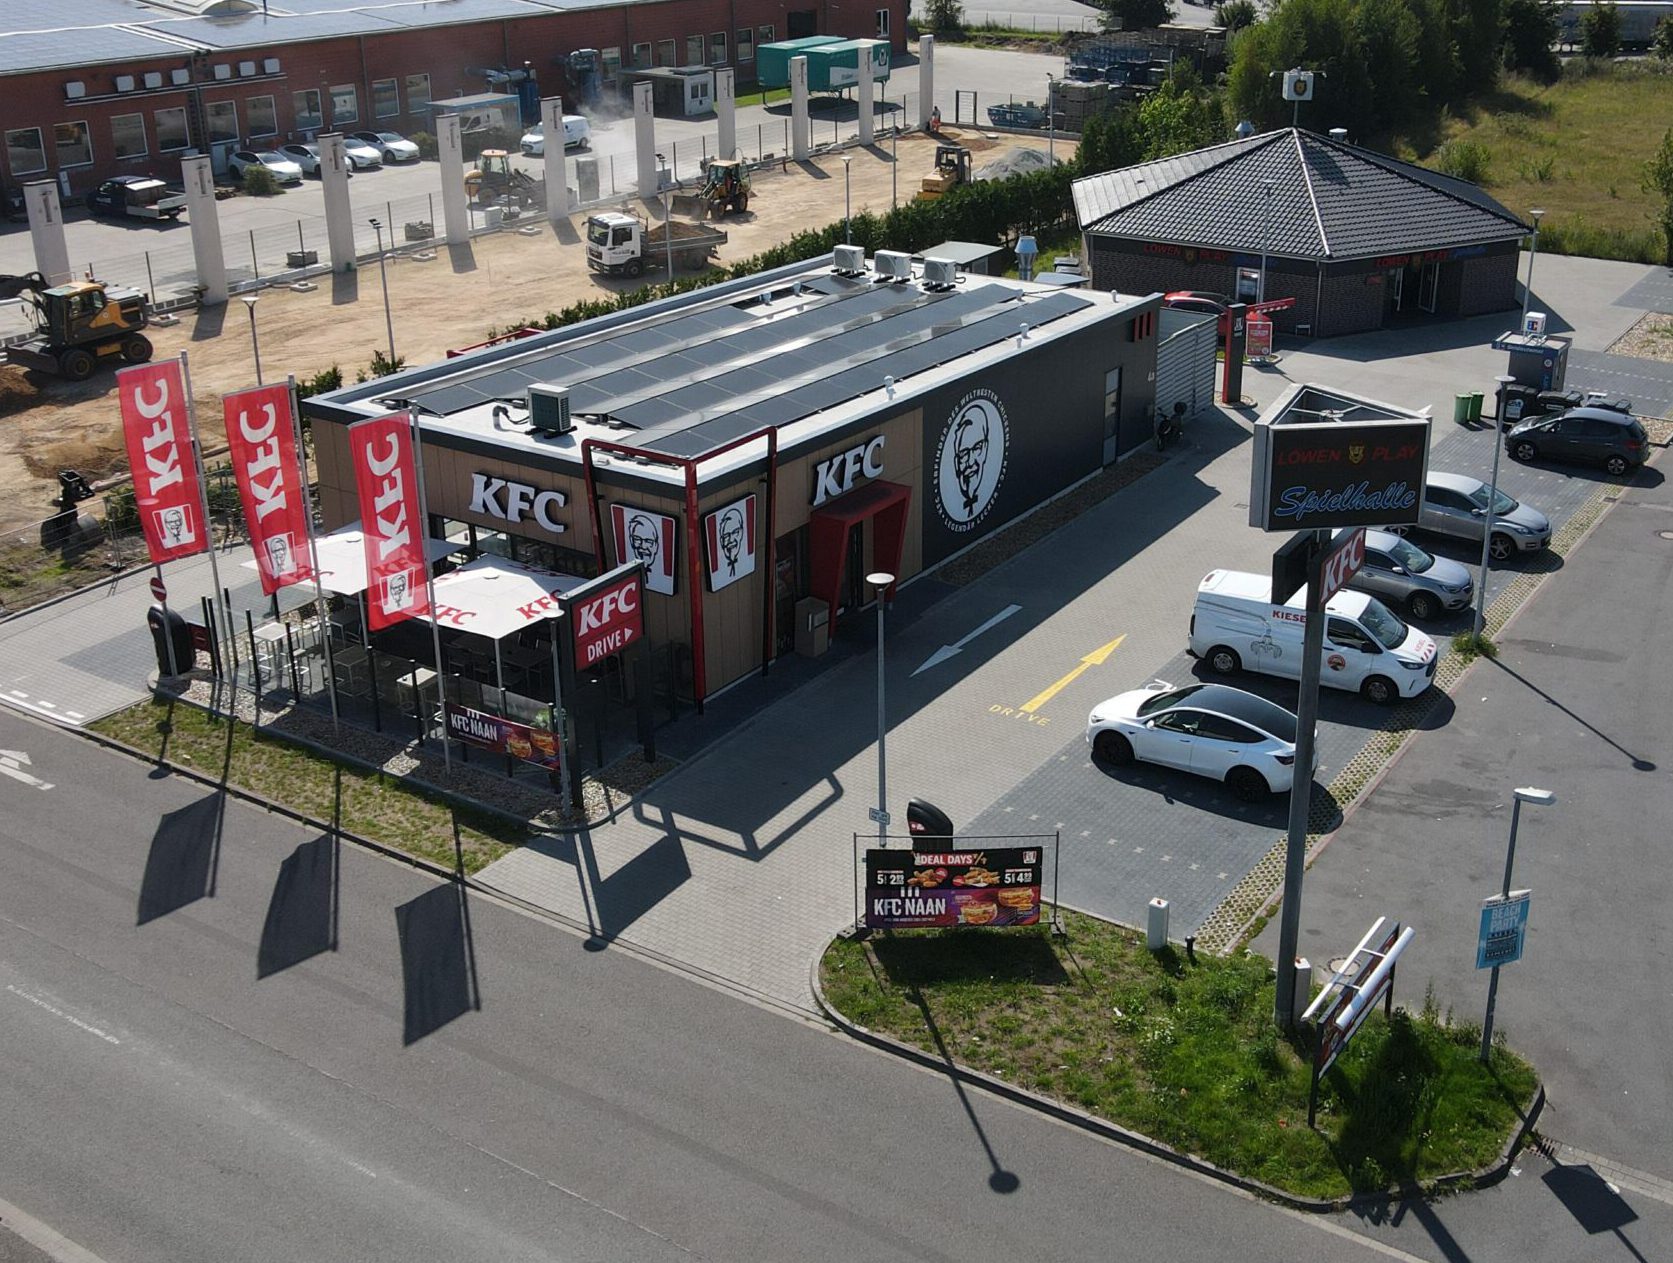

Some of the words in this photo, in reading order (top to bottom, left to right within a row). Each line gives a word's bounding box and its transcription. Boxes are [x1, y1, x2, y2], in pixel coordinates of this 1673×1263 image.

[134, 378, 184, 496] KFC
[239, 402, 287, 524] KFC
[1371, 445, 1419, 462] PLAY
[813, 435, 885, 507] KFC
[366, 432, 410, 561] KFC
[469, 472, 565, 533] KFC
[1274, 480, 1416, 521] Spielhalle
[1320, 531, 1364, 603] KFC
[578, 582, 636, 637] KFC
[1272, 610, 1307, 623] KIESE
[587, 630, 622, 662] DRIVE
[450, 713, 469, 734] KFC
[470, 719, 498, 741] NAAN
[988, 704, 1051, 726] DRIVE
[921, 855, 946, 865] DEAL
[948, 854, 973, 865] DAYS
[874, 898, 902, 916] KFC
[905, 898, 946, 916] NAAN
[1492, 904, 1521, 920] BEACH
[1490, 916, 1519, 933] PARTY
